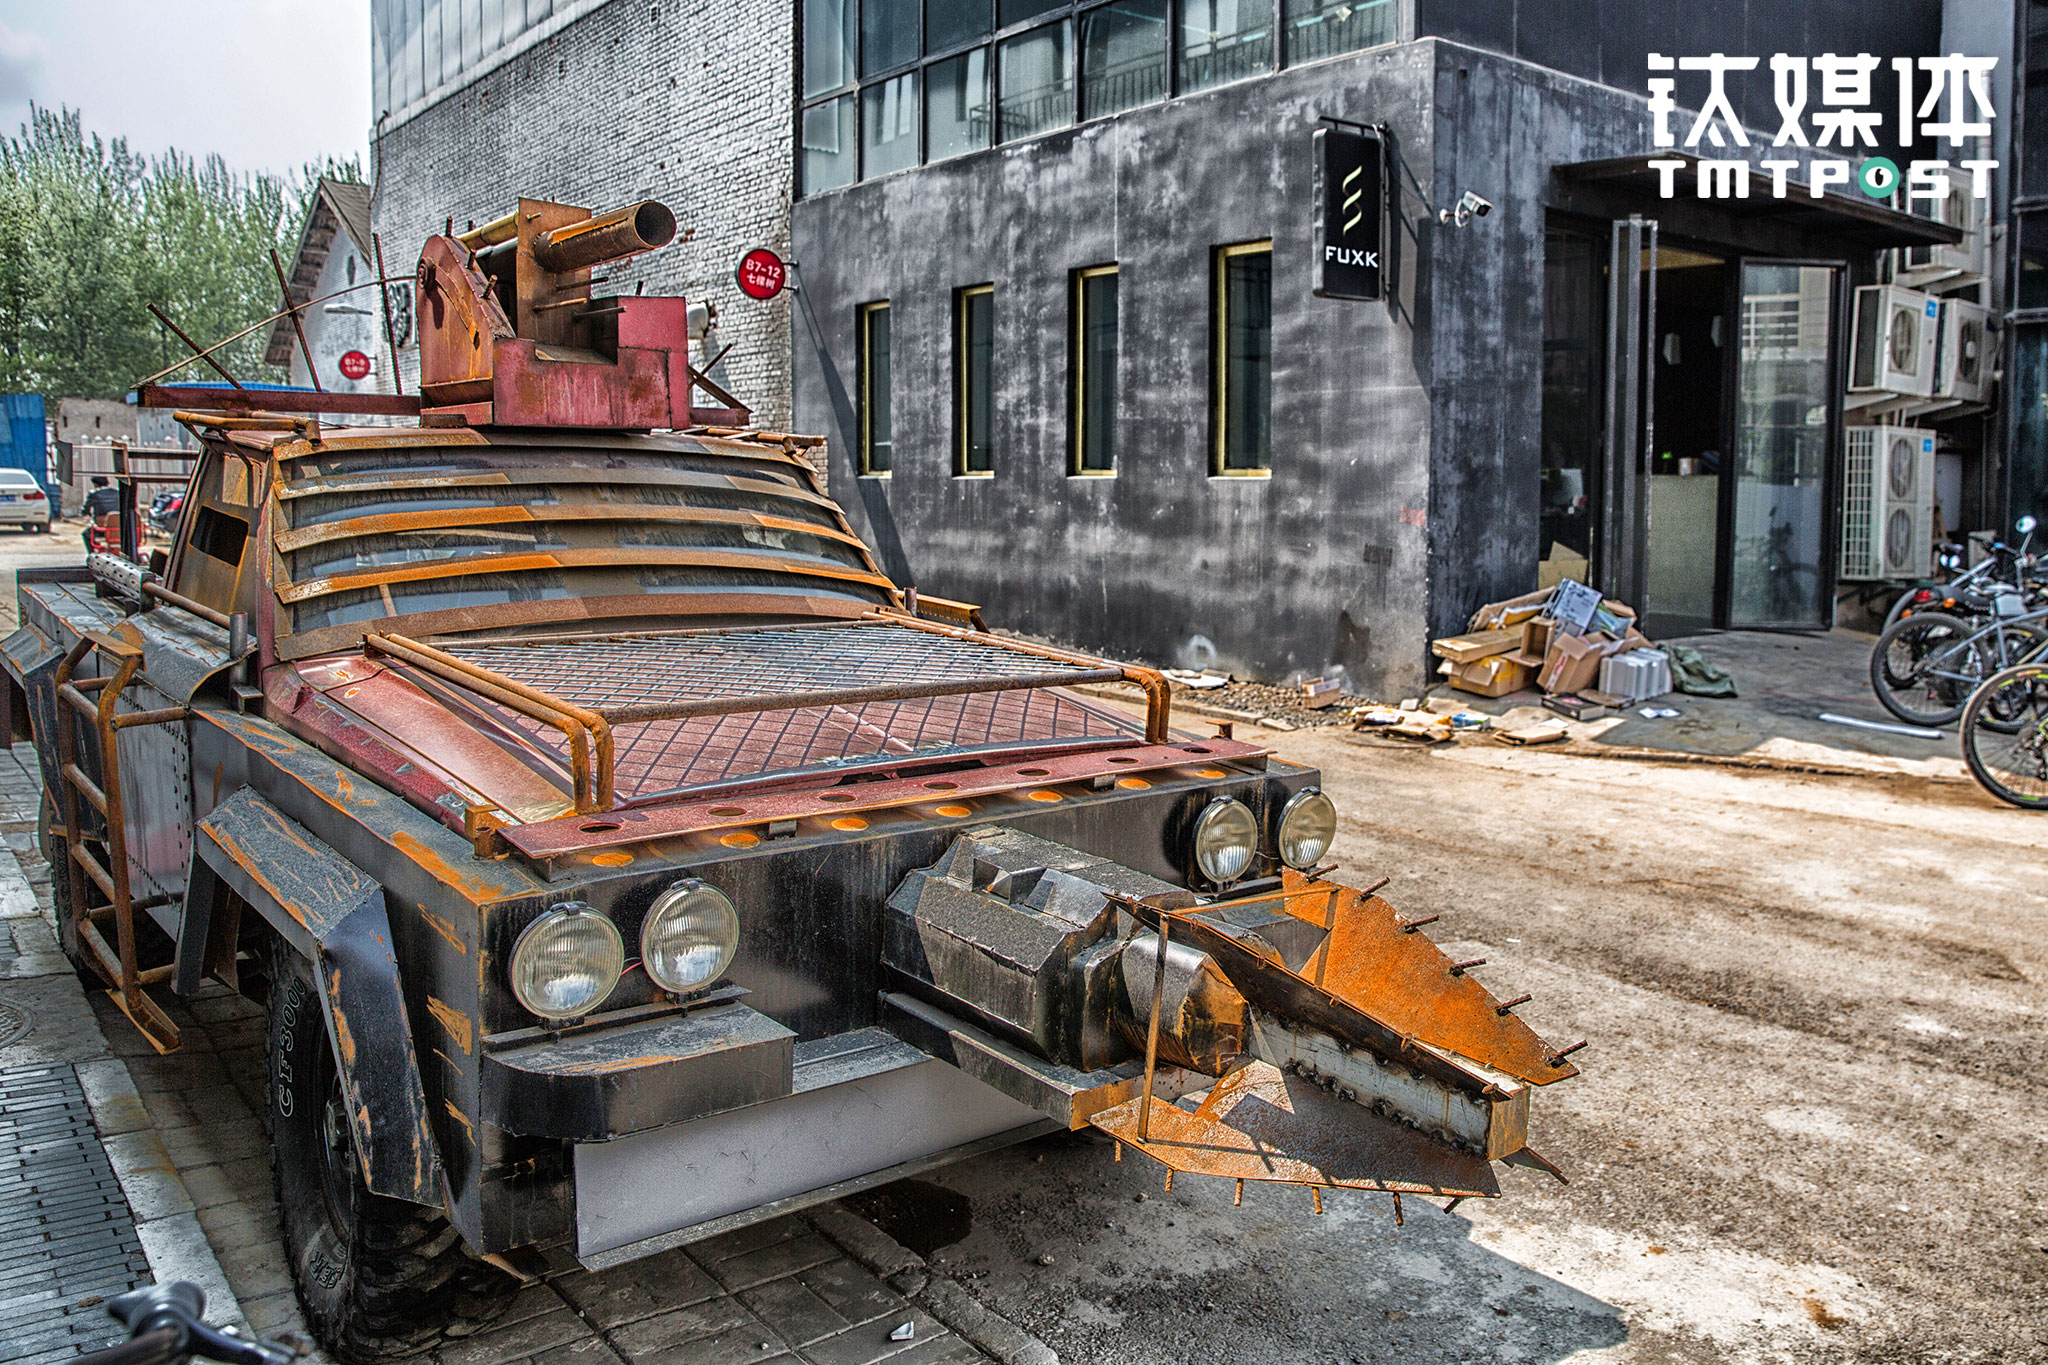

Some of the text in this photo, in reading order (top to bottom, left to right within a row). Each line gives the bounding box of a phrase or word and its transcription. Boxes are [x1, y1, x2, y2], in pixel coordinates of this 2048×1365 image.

[1325, 245, 1379, 268] FUXK
[745, 258, 781, 279] B7-12
[279, 976, 306, 1118] CF3000
